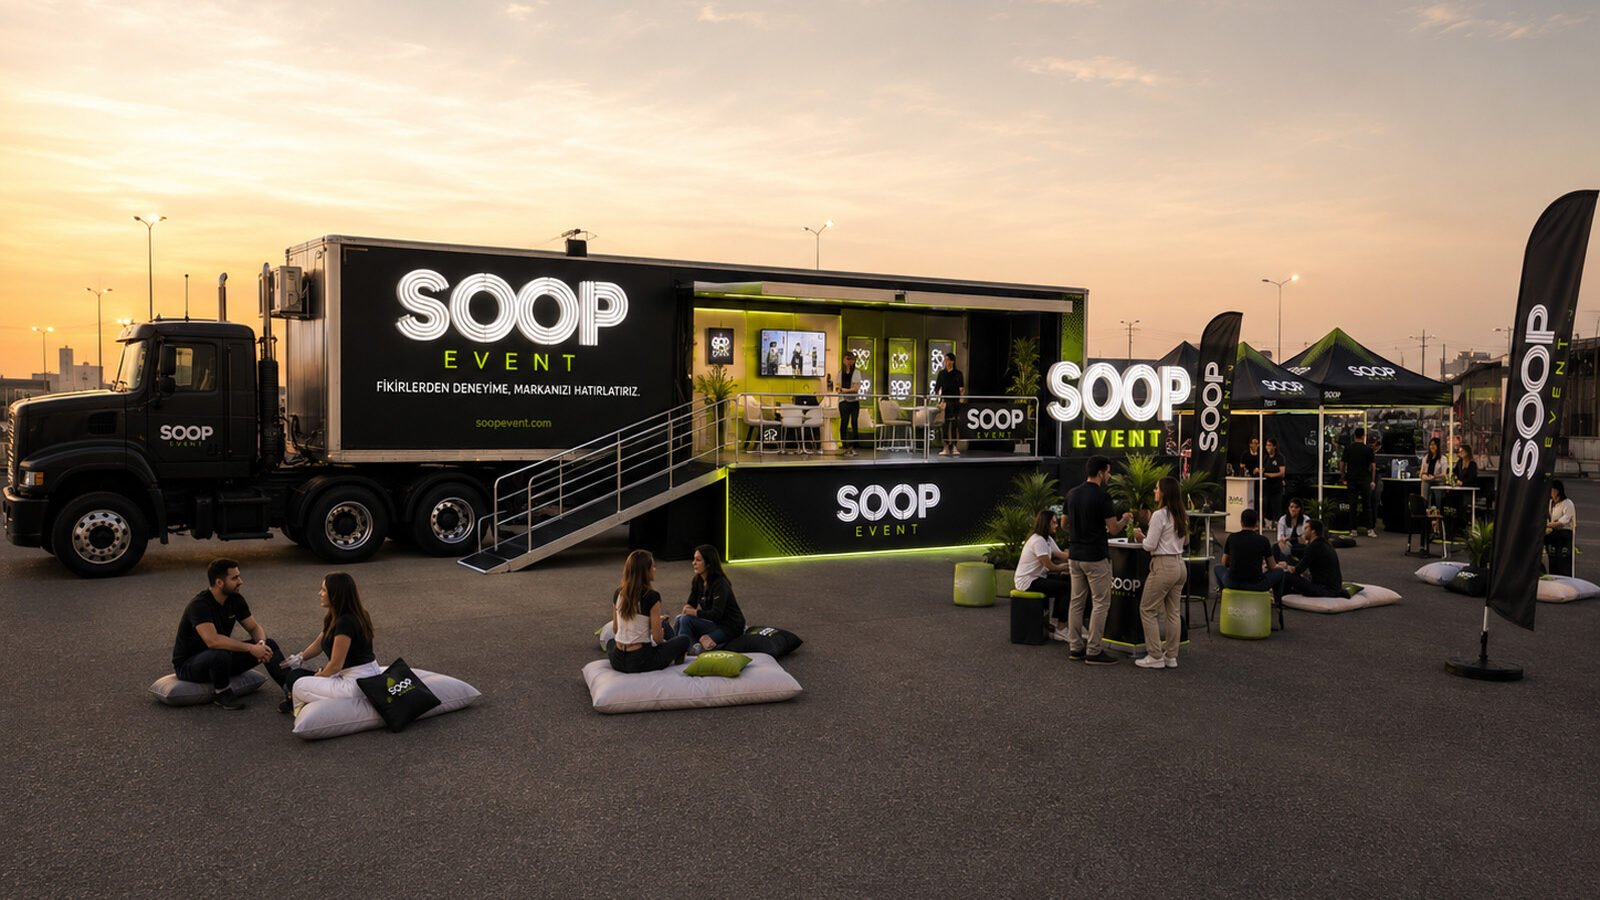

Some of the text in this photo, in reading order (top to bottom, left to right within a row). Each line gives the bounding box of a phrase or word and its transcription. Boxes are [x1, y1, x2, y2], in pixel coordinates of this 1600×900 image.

[395, 268, 629, 346] SOOP
[444, 350, 576, 372] EVENT
[1347, 365, 1396, 378] SOOP
[376, 378, 641, 397] FİKİRLERDEN DENEYİME, MARKANIZI HATIRLATIRIZ.
[1047, 361, 1192, 422] SOOP
[1261, 379, 1305, 393] SOOP
[1511, 303, 1556, 481] SOOP
[1544, 338, 1570, 449] EVENT
[1199, 361, 1224, 453] SOOP
[1220, 379, 1232, 436] EVENT
[475, 418, 552, 429] soopevent.com
[967, 408, 1024, 430] SOOP
[160, 425, 214, 441] SOOP
[1072, 429, 1162, 448] EVENT
[836, 483, 942, 522] SOOP
[855, 523, 920, 538] EVENT
